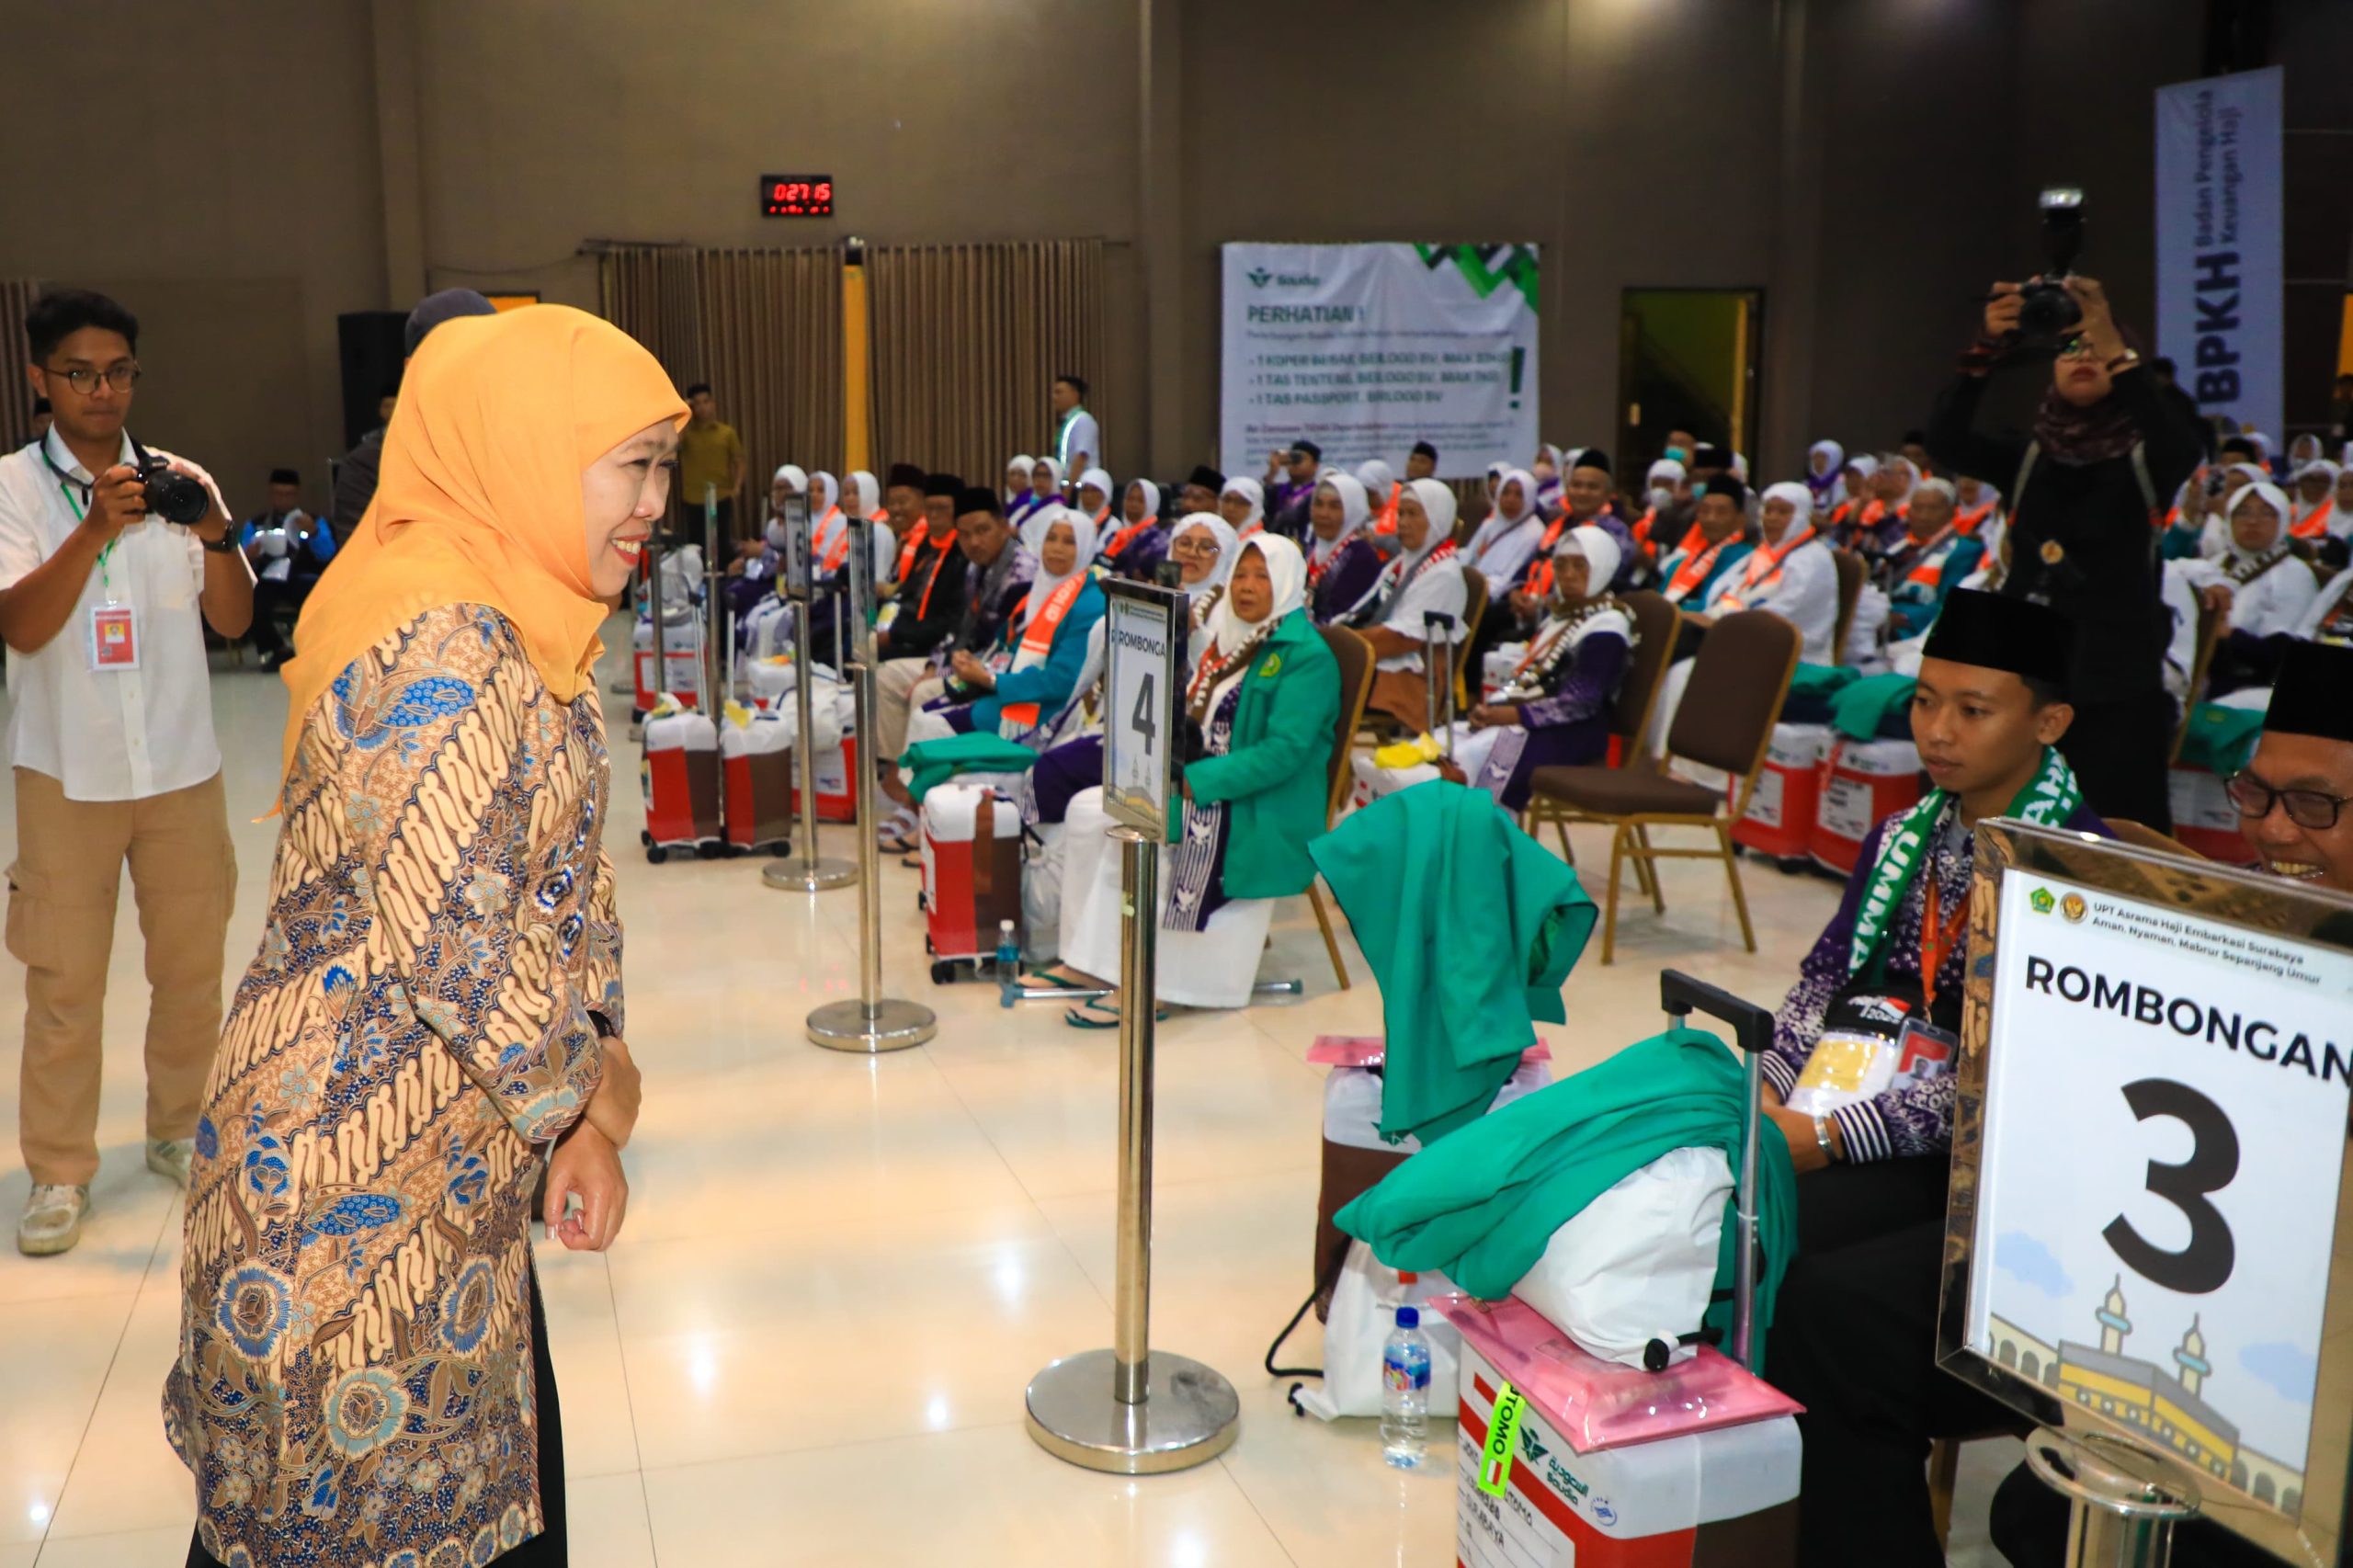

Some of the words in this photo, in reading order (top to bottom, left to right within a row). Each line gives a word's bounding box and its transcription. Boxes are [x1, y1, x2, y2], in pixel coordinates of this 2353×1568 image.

[2218, 107, 2243, 145] Haji
[2194, 187, 2214, 247] Badan
[2220, 150, 2243, 244] Keuangan
[2195, 251, 2241, 404] BPKH
[1131, 672, 1156, 756] 4
[2093, 902, 2115, 916] UPT
[2117, 909, 2159, 928] Asrama
[2161, 919, 2183, 935] Haji
[2185, 926, 2245, 949] Embarkasi
[2248, 941, 2304, 965] Surabaya
[2178, 939, 2221, 958] Mabrur
[2222, 950, 2284, 976] Sepanjang
[2286, 967, 2322, 985] Umur
[2025, 954, 2353, 1089] ROMBONGAN
[2101, 1077, 2241, 1294] 3
[1547, 1471, 1578, 1506] Saudia
